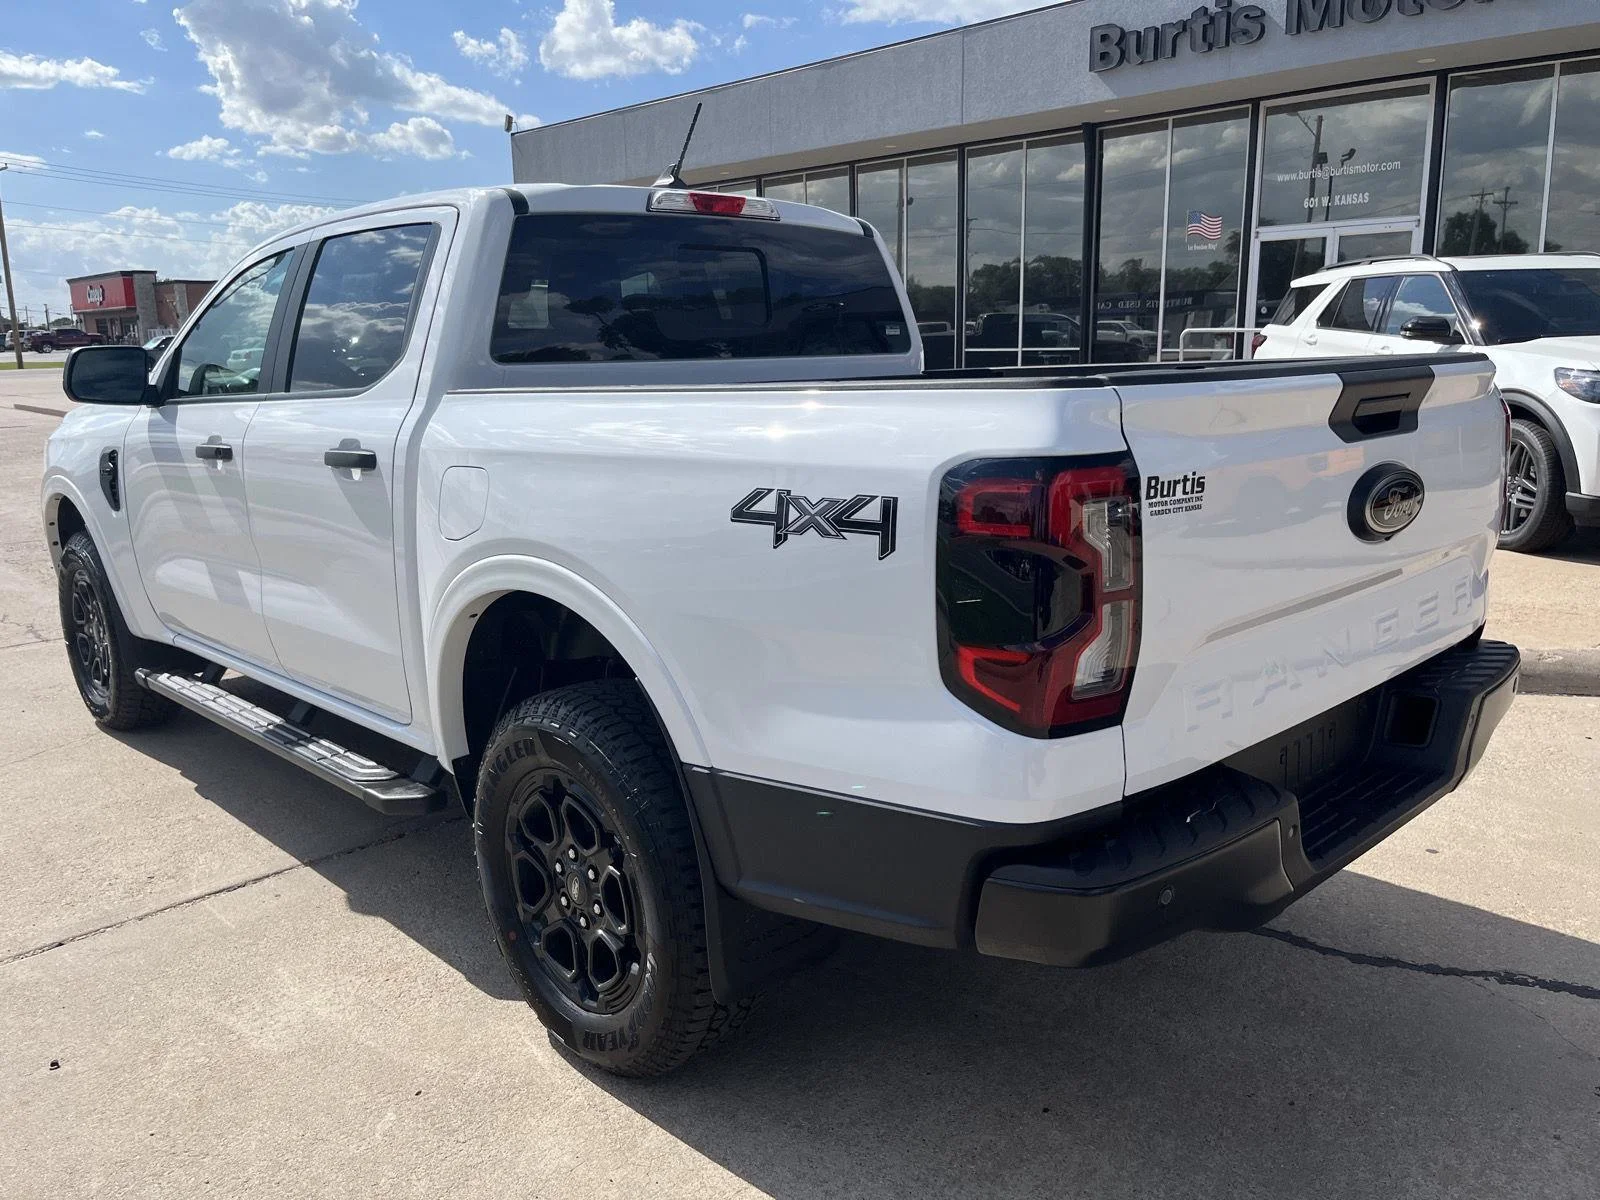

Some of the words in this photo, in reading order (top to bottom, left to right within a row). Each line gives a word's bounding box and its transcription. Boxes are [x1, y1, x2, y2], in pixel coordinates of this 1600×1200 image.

[1089, 0, 1266, 72] Burtis
[1277, 160, 1401, 182] www.burtis@burtismotor.com
[1303, 198, 1319, 209] 601
[1321, 196, 1332, 208] W.
[1334, 192, 1370, 206] KANSAS
[1145, 471, 1206, 500] Burtis
[1148, 501, 1169, 509] MOTOR
[1169, 496, 1194, 506] COMPANY
[1150, 508, 1172, 517] GARDEN
[1172, 506, 1185, 514] CITY
[1185, 503, 1202, 512] KANSAS
